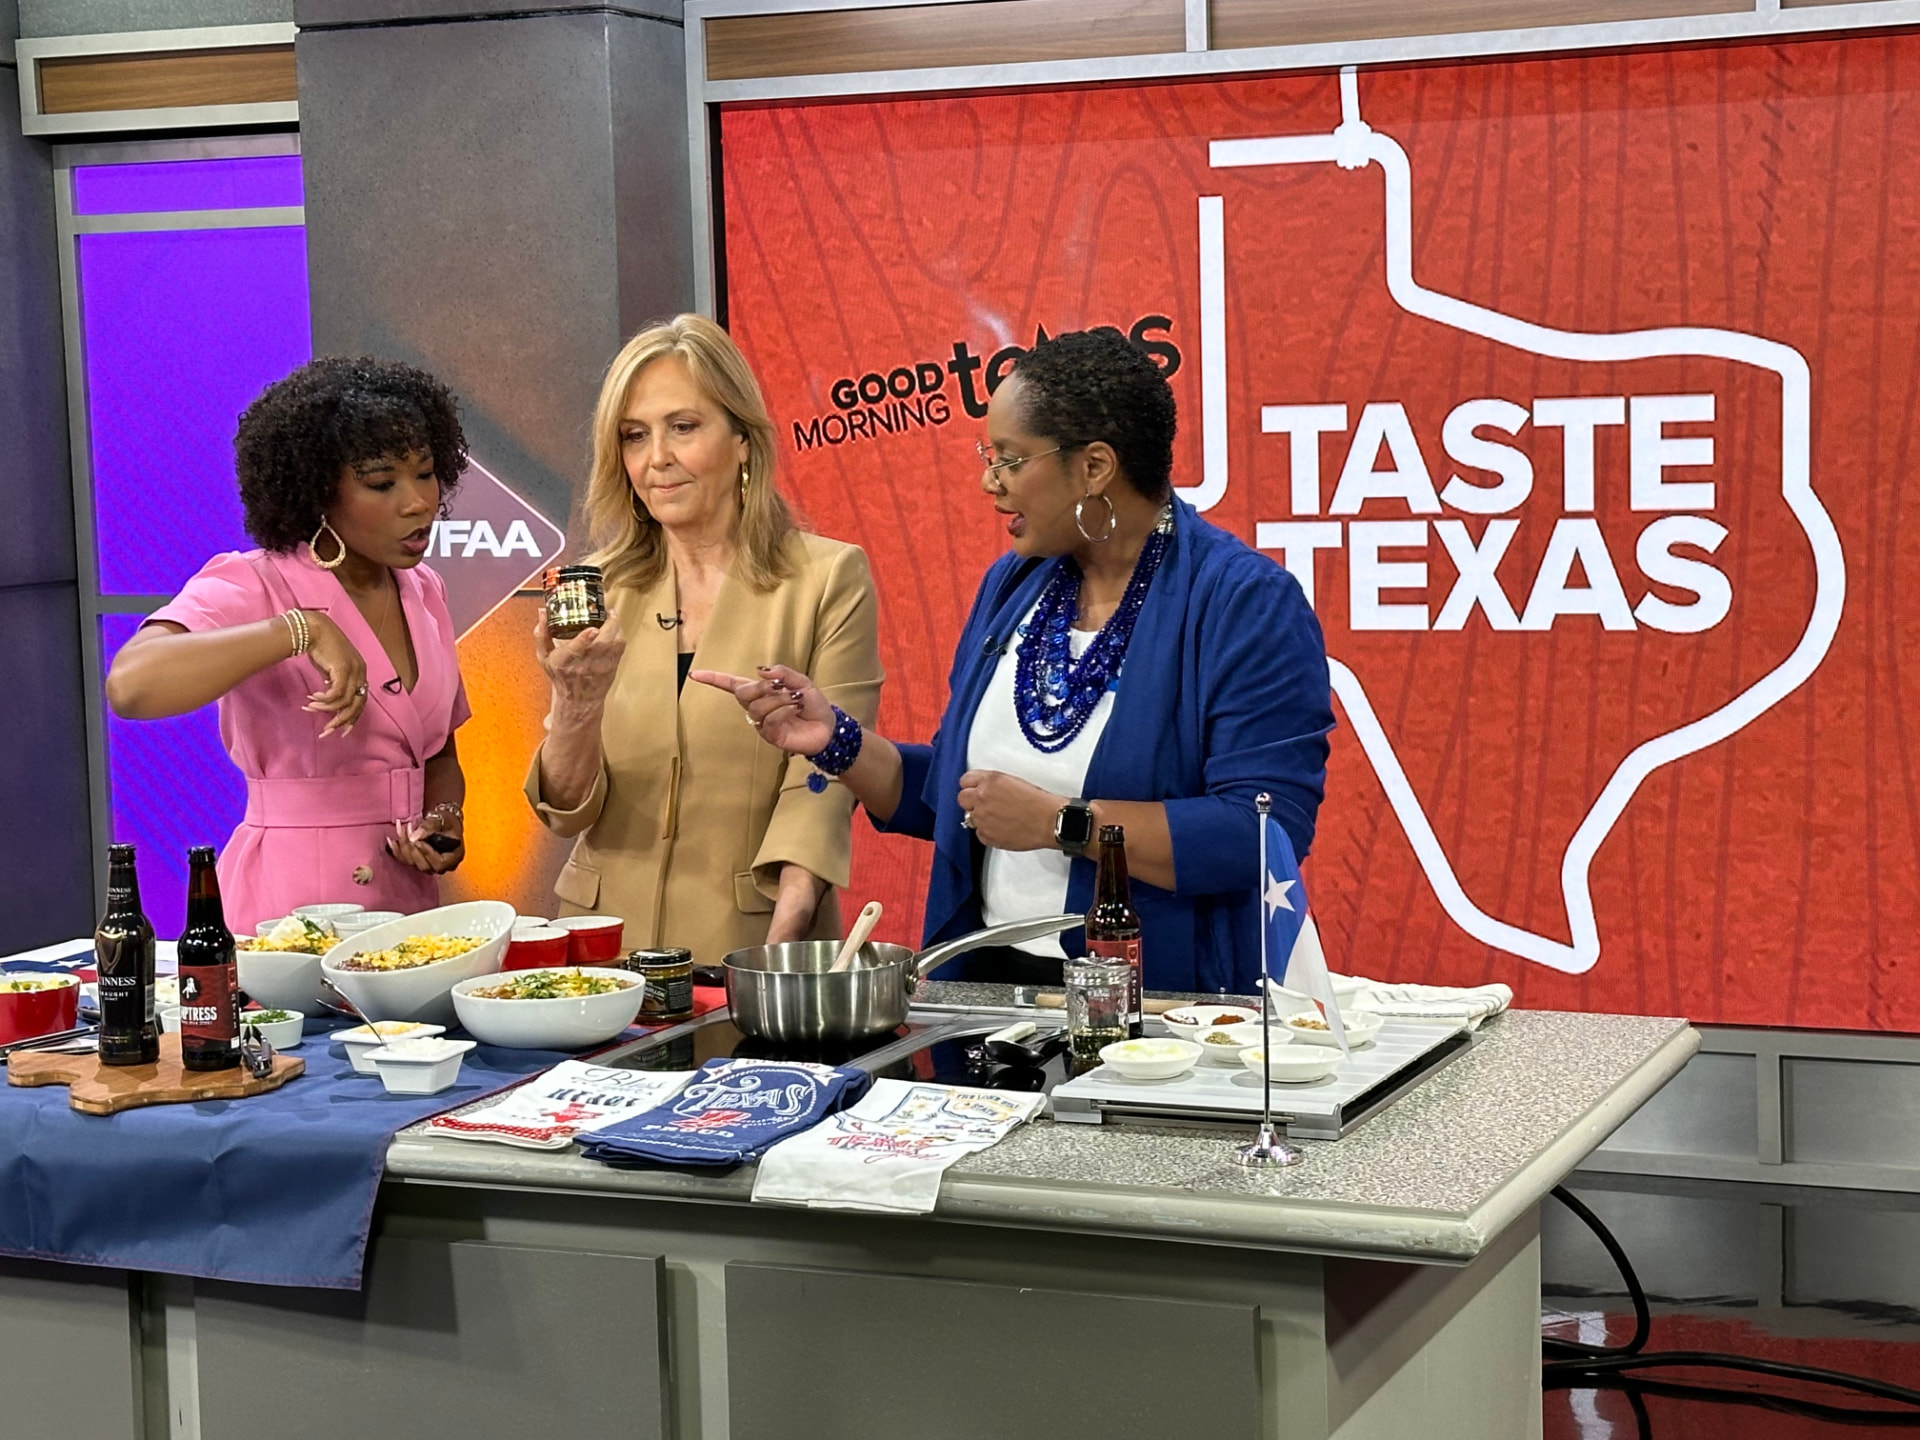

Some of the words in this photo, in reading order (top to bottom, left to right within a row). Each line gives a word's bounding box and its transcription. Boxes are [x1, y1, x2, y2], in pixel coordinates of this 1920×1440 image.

[792, 394, 951, 452] MORNING
[831, 362, 944, 410] GOOD
[1261, 394, 1715, 515] TASTE
[1256, 515, 1733, 634] TEXAS
